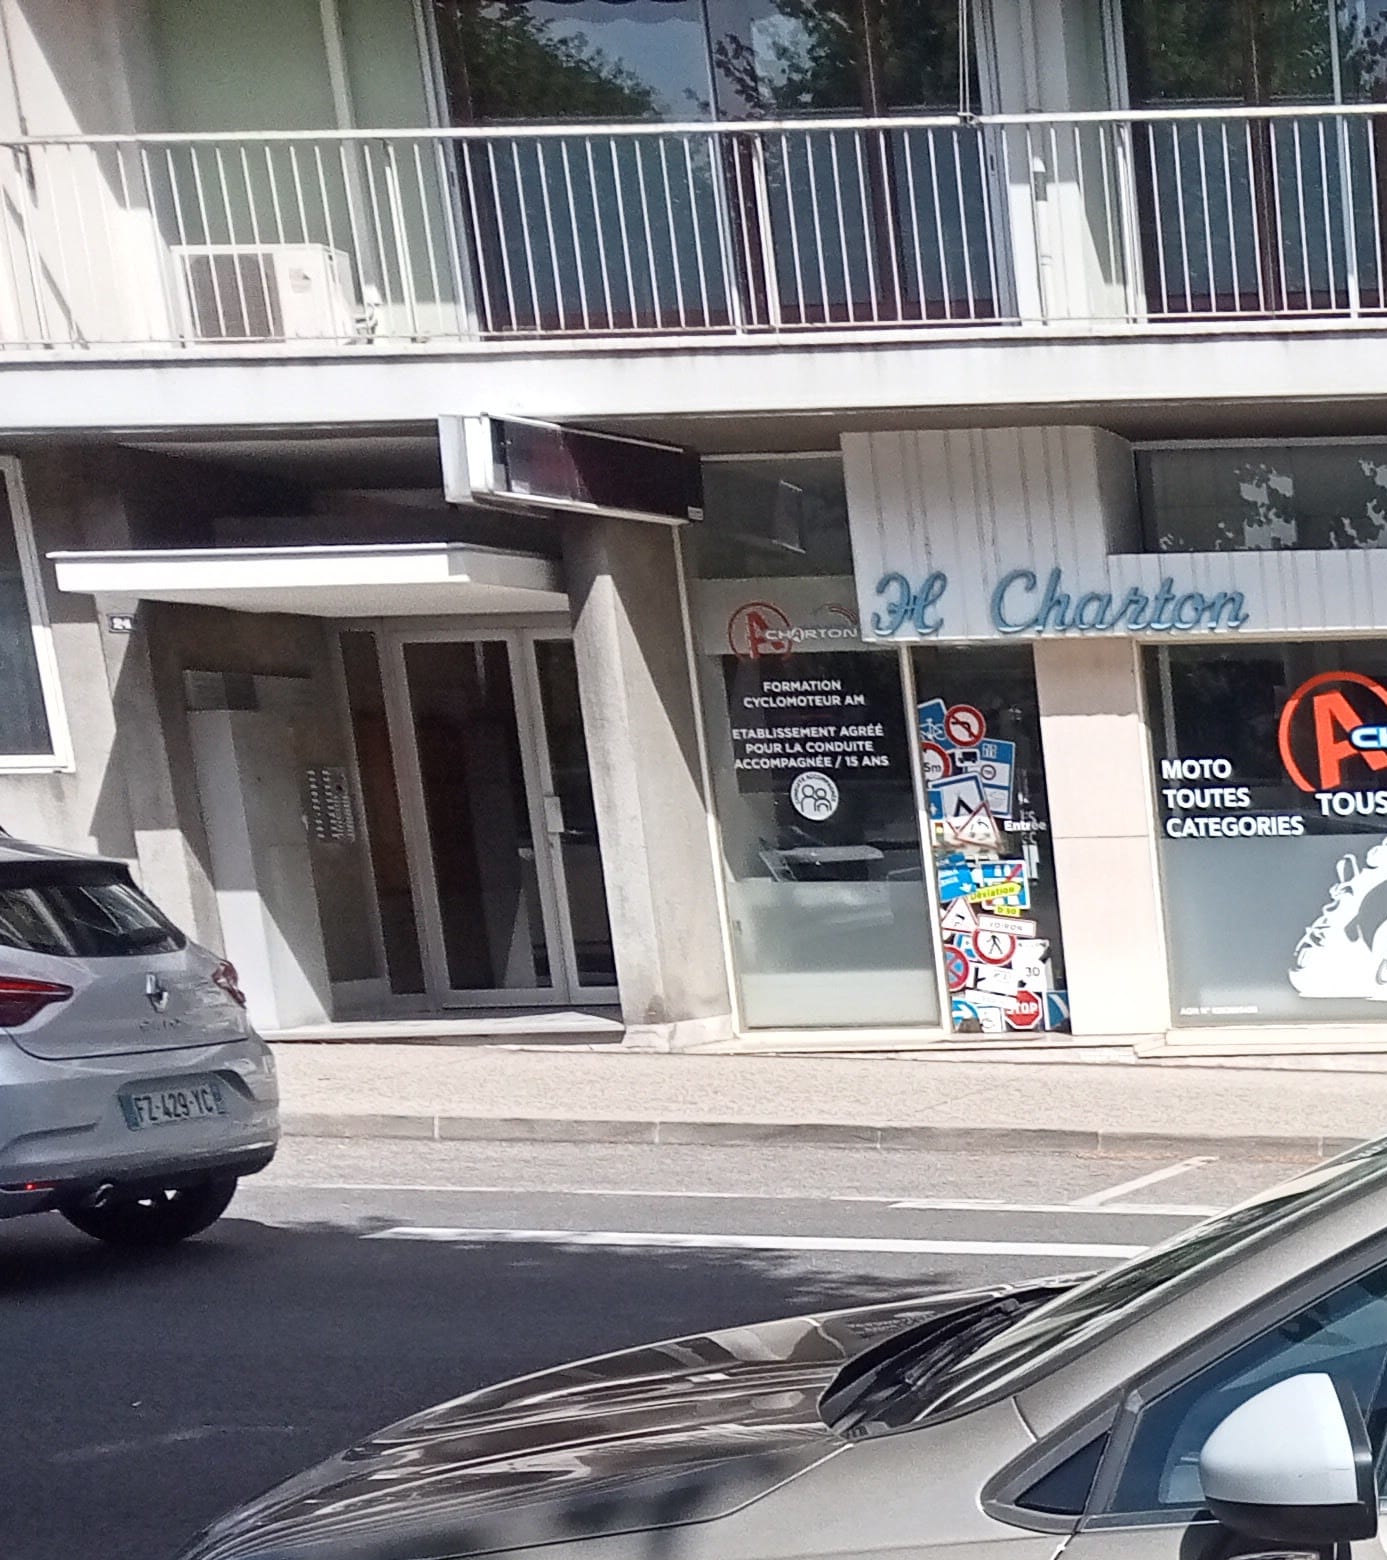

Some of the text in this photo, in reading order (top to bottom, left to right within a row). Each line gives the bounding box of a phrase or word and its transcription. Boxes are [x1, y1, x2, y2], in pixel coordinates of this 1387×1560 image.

[988, 566, 1250, 634] Charton
[763, 680, 842, 693] FORMATION
[743, 695, 865, 708] CYCLOMOTEUR AM
[732, 723, 884, 740] ETABLISSEMENT AGRÉÉ
[745, 741, 875, 754] POUR LA CONDUITE
[734, 755, 832, 769] ACCOMPAGNÉE
[845, 756, 859, 768] 15
[862, 755, 890, 767] ANS
[1161, 758, 1233, 781] MOTO
[1163, 787, 1251, 810] TOUTES
[1166, 816, 1305, 839] CATEGORIES
[134, 1087, 213, 1122] FZ-429-YC
